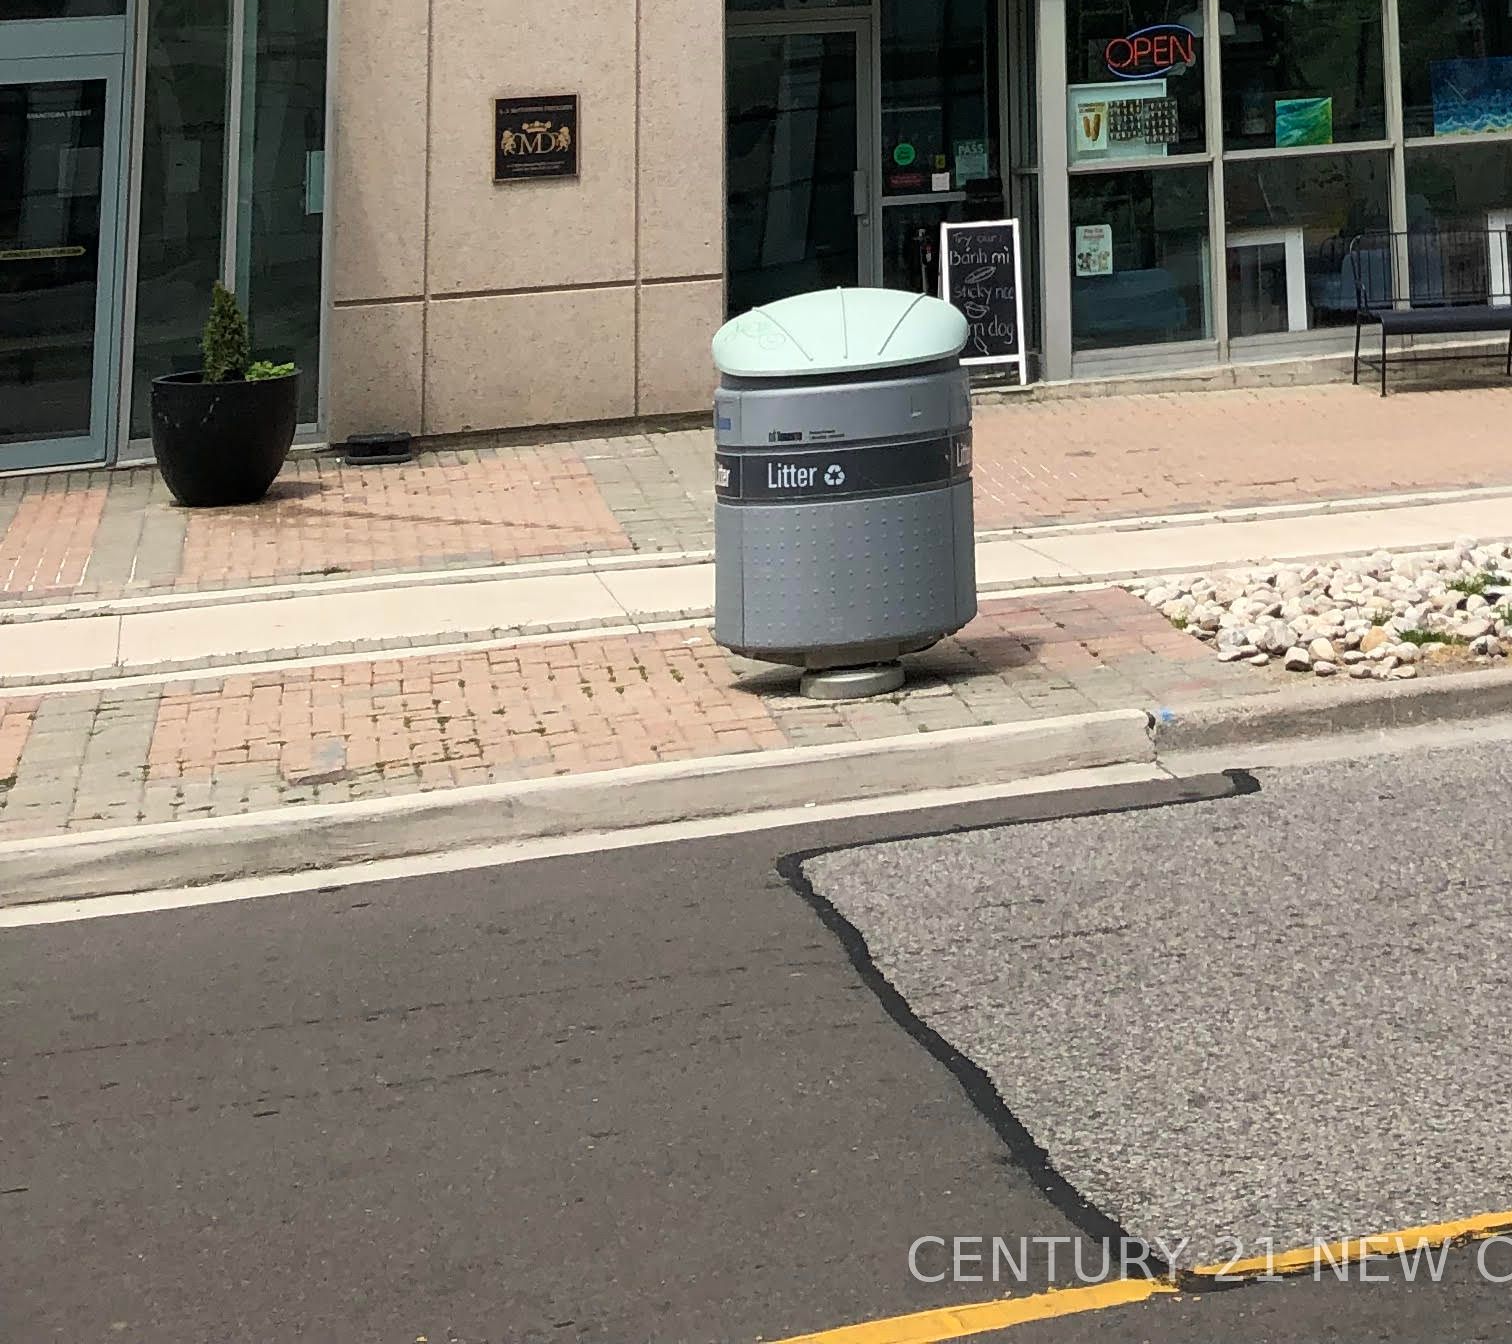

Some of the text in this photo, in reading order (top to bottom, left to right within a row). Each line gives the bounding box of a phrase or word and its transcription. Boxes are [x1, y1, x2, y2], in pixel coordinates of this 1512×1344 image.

[1105, 33, 1194, 68] OPEN
[959, 143, 985, 155] PASS
[768, 462, 818, 489] Litter
